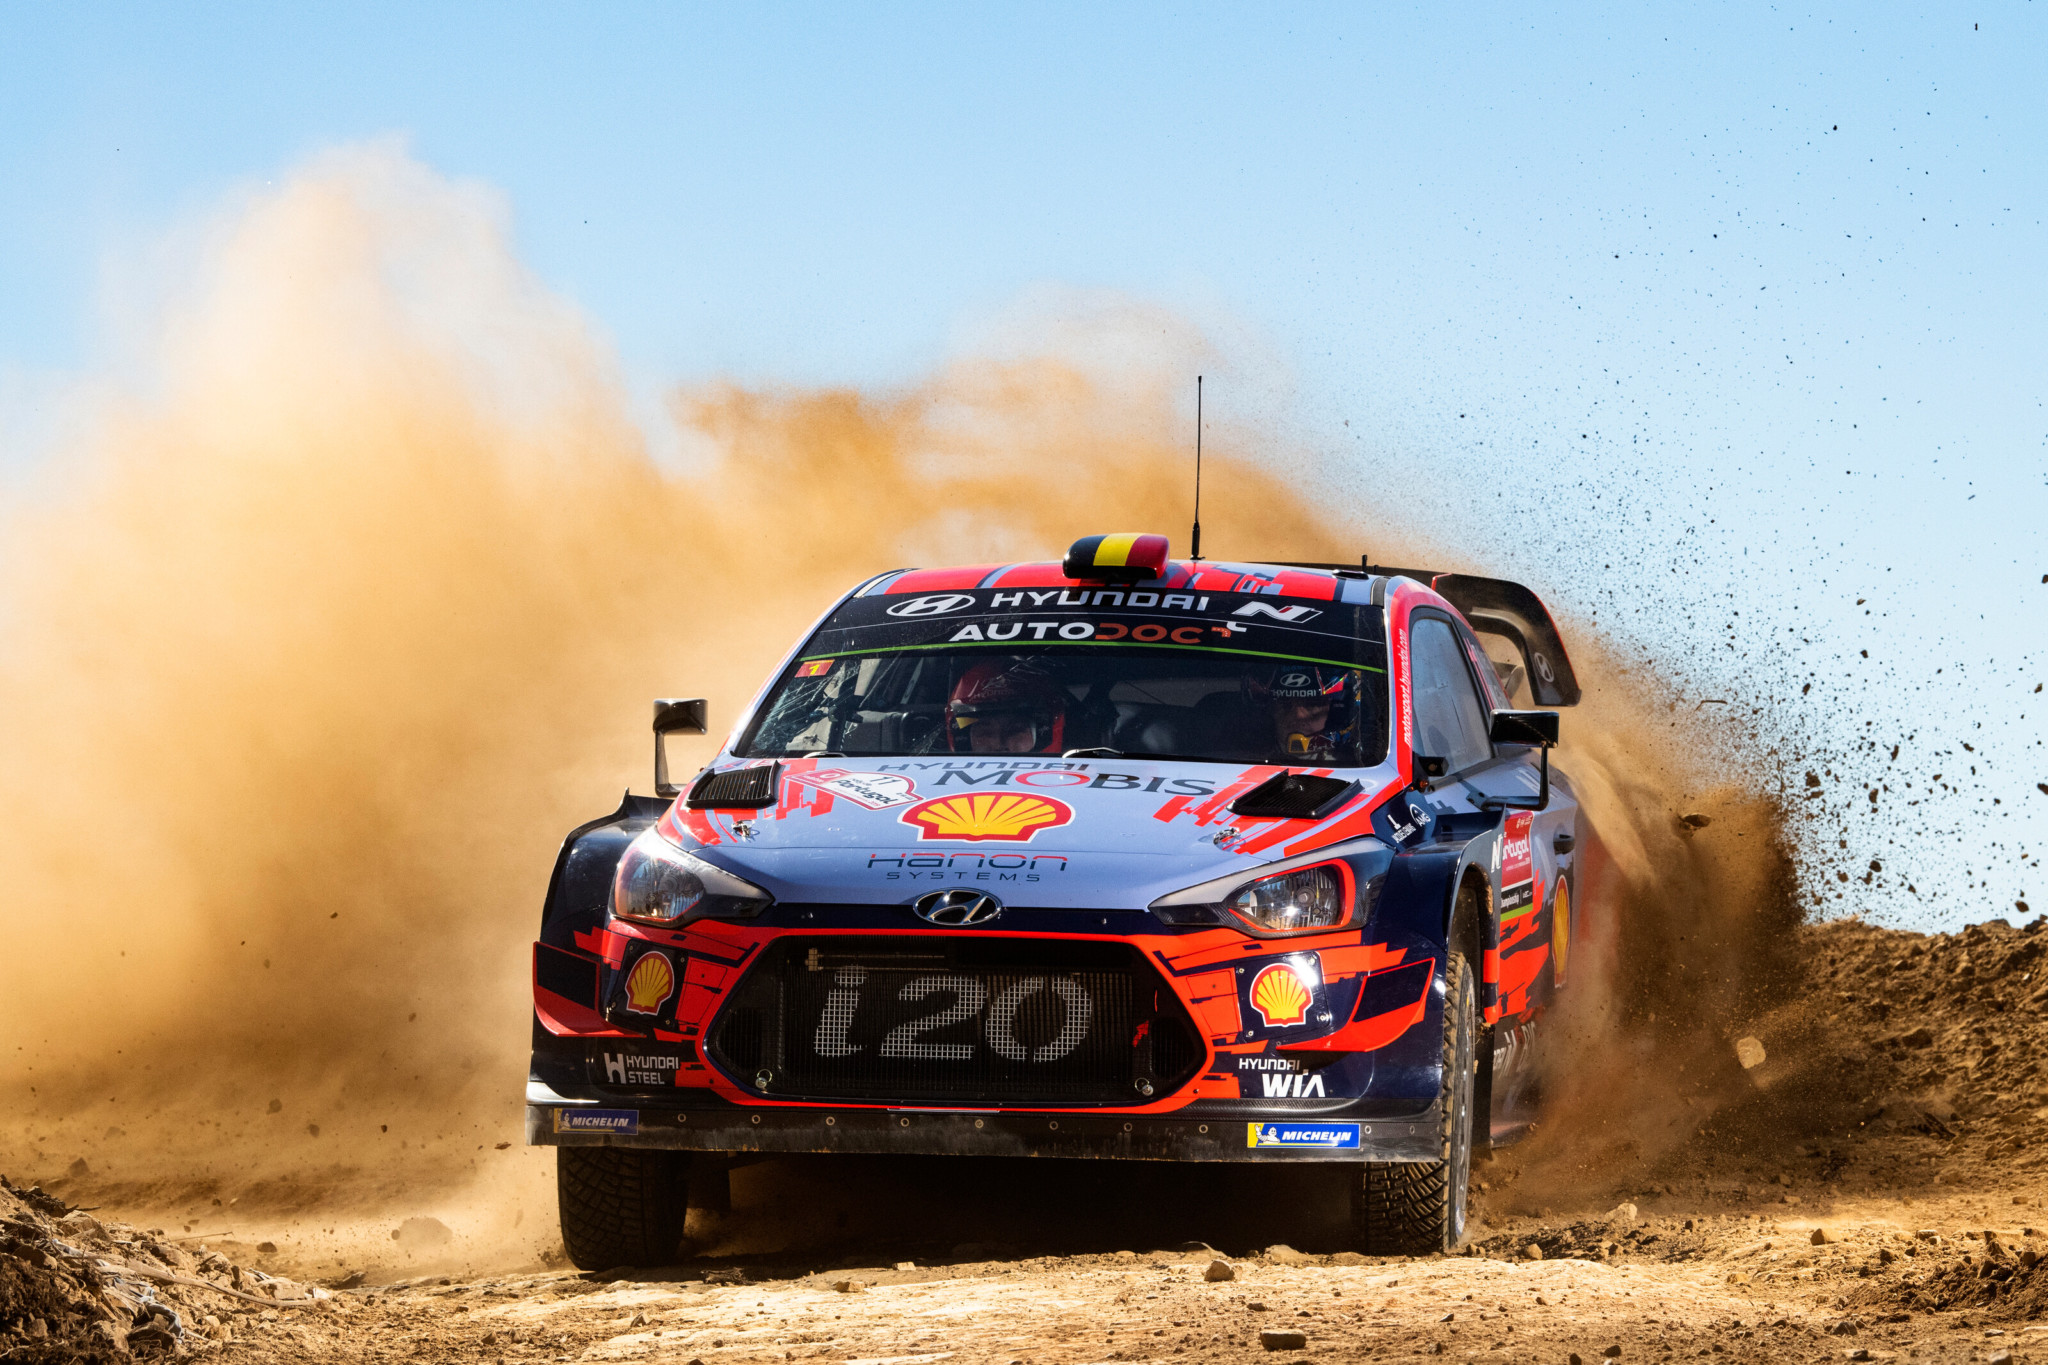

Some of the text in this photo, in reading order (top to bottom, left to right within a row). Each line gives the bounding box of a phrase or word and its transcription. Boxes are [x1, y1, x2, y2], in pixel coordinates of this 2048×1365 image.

[990, 590, 1210, 612] HYUNDAI
[948, 622, 1204, 645] AUTODOC
[808, 664, 821, 676] 1
[1272, 688, 1317, 698] HYUNDAI
[1397, 628, 1412, 748] motorsport.hyundai.com
[877, 761, 1089, 772] HYUNDAI
[931, 770, 1216, 797] MOBIS
[829, 779, 898, 804] Portugal
[886, 871, 1041, 882] SYSTEMS
[813, 965, 1093, 1063] i20
[626, 1055, 680, 1070] HYUNDAI
[1239, 1058, 1300, 1071] HYUNDAI
[628, 1071, 665, 1085] STEEL
[1262, 1072, 1326, 1098] WIA
[571, 1116, 629, 1128] MICHELIN
[1281, 1131, 1352, 1142] MICHELIN
